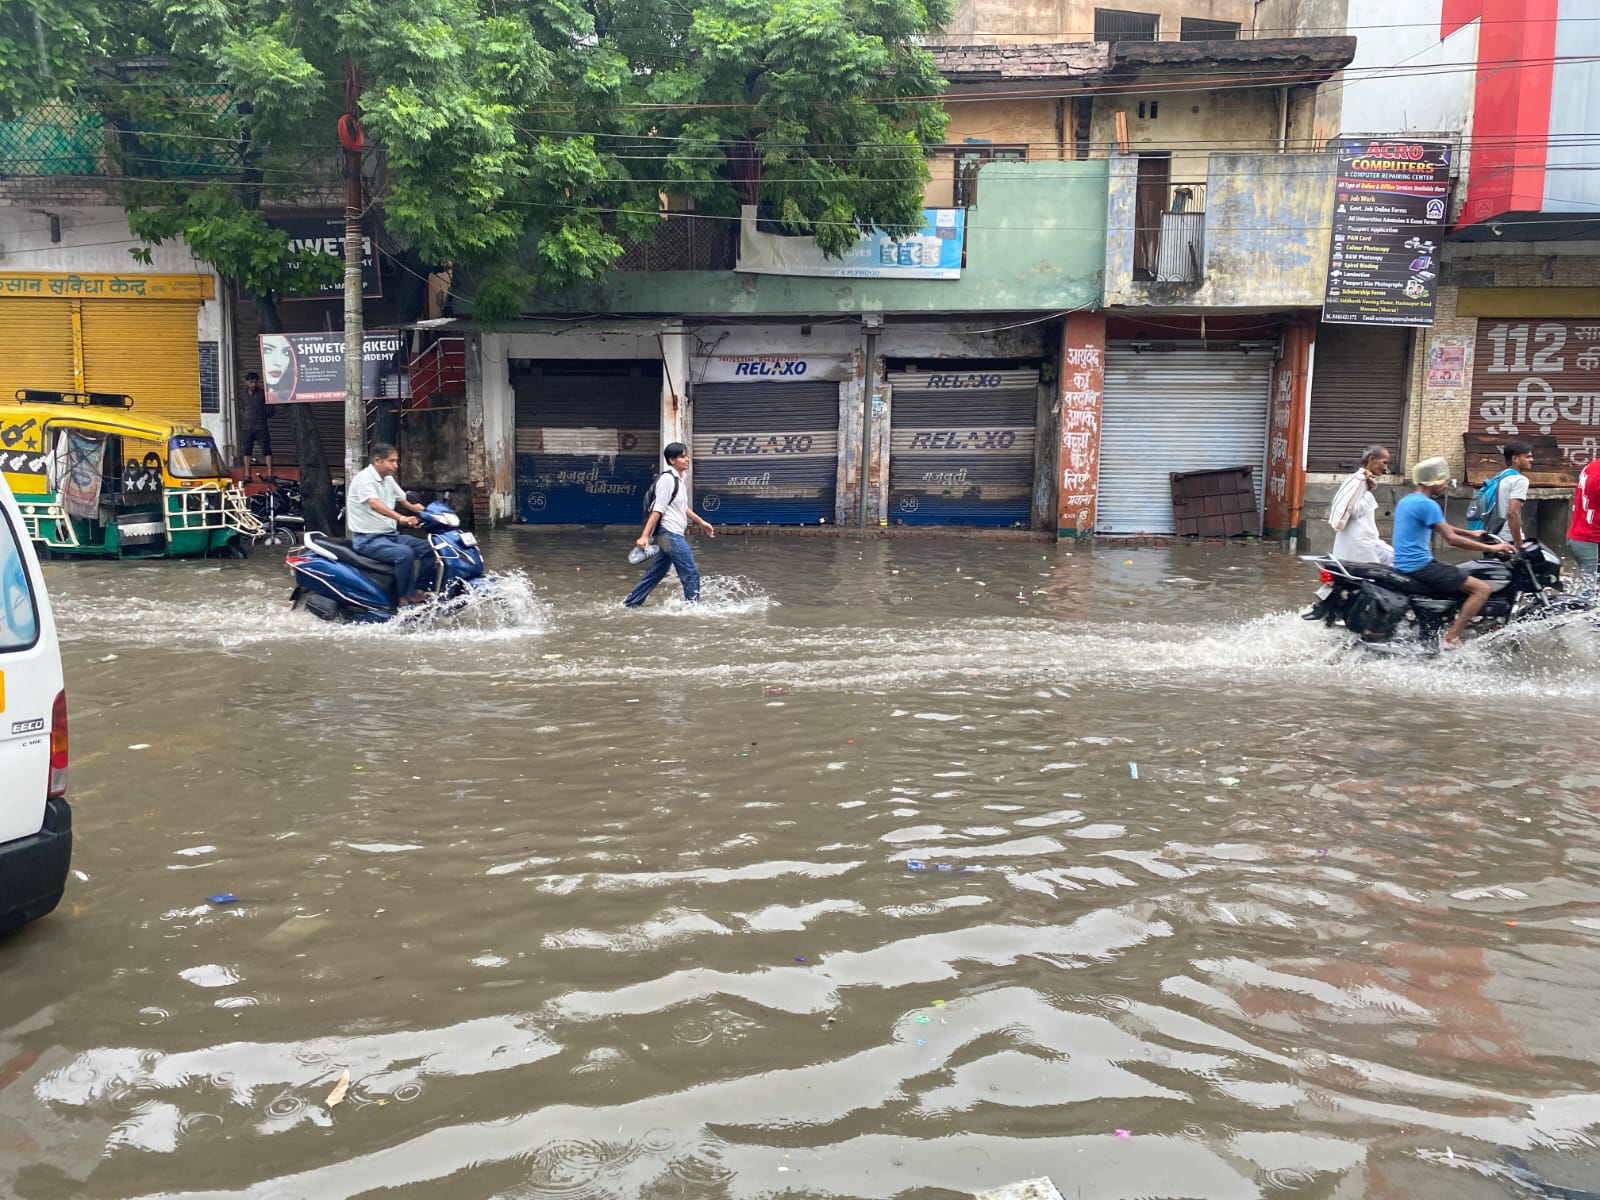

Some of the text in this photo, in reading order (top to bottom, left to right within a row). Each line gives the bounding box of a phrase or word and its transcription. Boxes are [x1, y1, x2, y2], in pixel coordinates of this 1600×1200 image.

[1365, 142, 1423, 160] ACRO
[1351, 160, 1434, 173] COMPUTERS
[1345, 182, 1355, 190] Type
[1370, 226, 1398, 234] Application
[1358, 254, 1383, 262] Photocopy
[1360, 262, 1378, 270] Binding
[48, 275, 105, 295] सुविधा
[109, 276, 147, 295] केन्द्र
[1342, 288, 1370, 296] Scholarship
[1487, 323, 1567, 373] 112
[308, 353, 394, 364] STUDIO ADEMY
[735, 362, 807, 375] RELAXO
[927, 374, 1002, 389] RELAXO
[711, 435, 813, 455] RELAXO
[909, 430, 1016, 449] RELAXO
[704, 497, 717, 507] 57
[902, 498, 916, 508] 58
[12, 720, 43, 733] EECO
